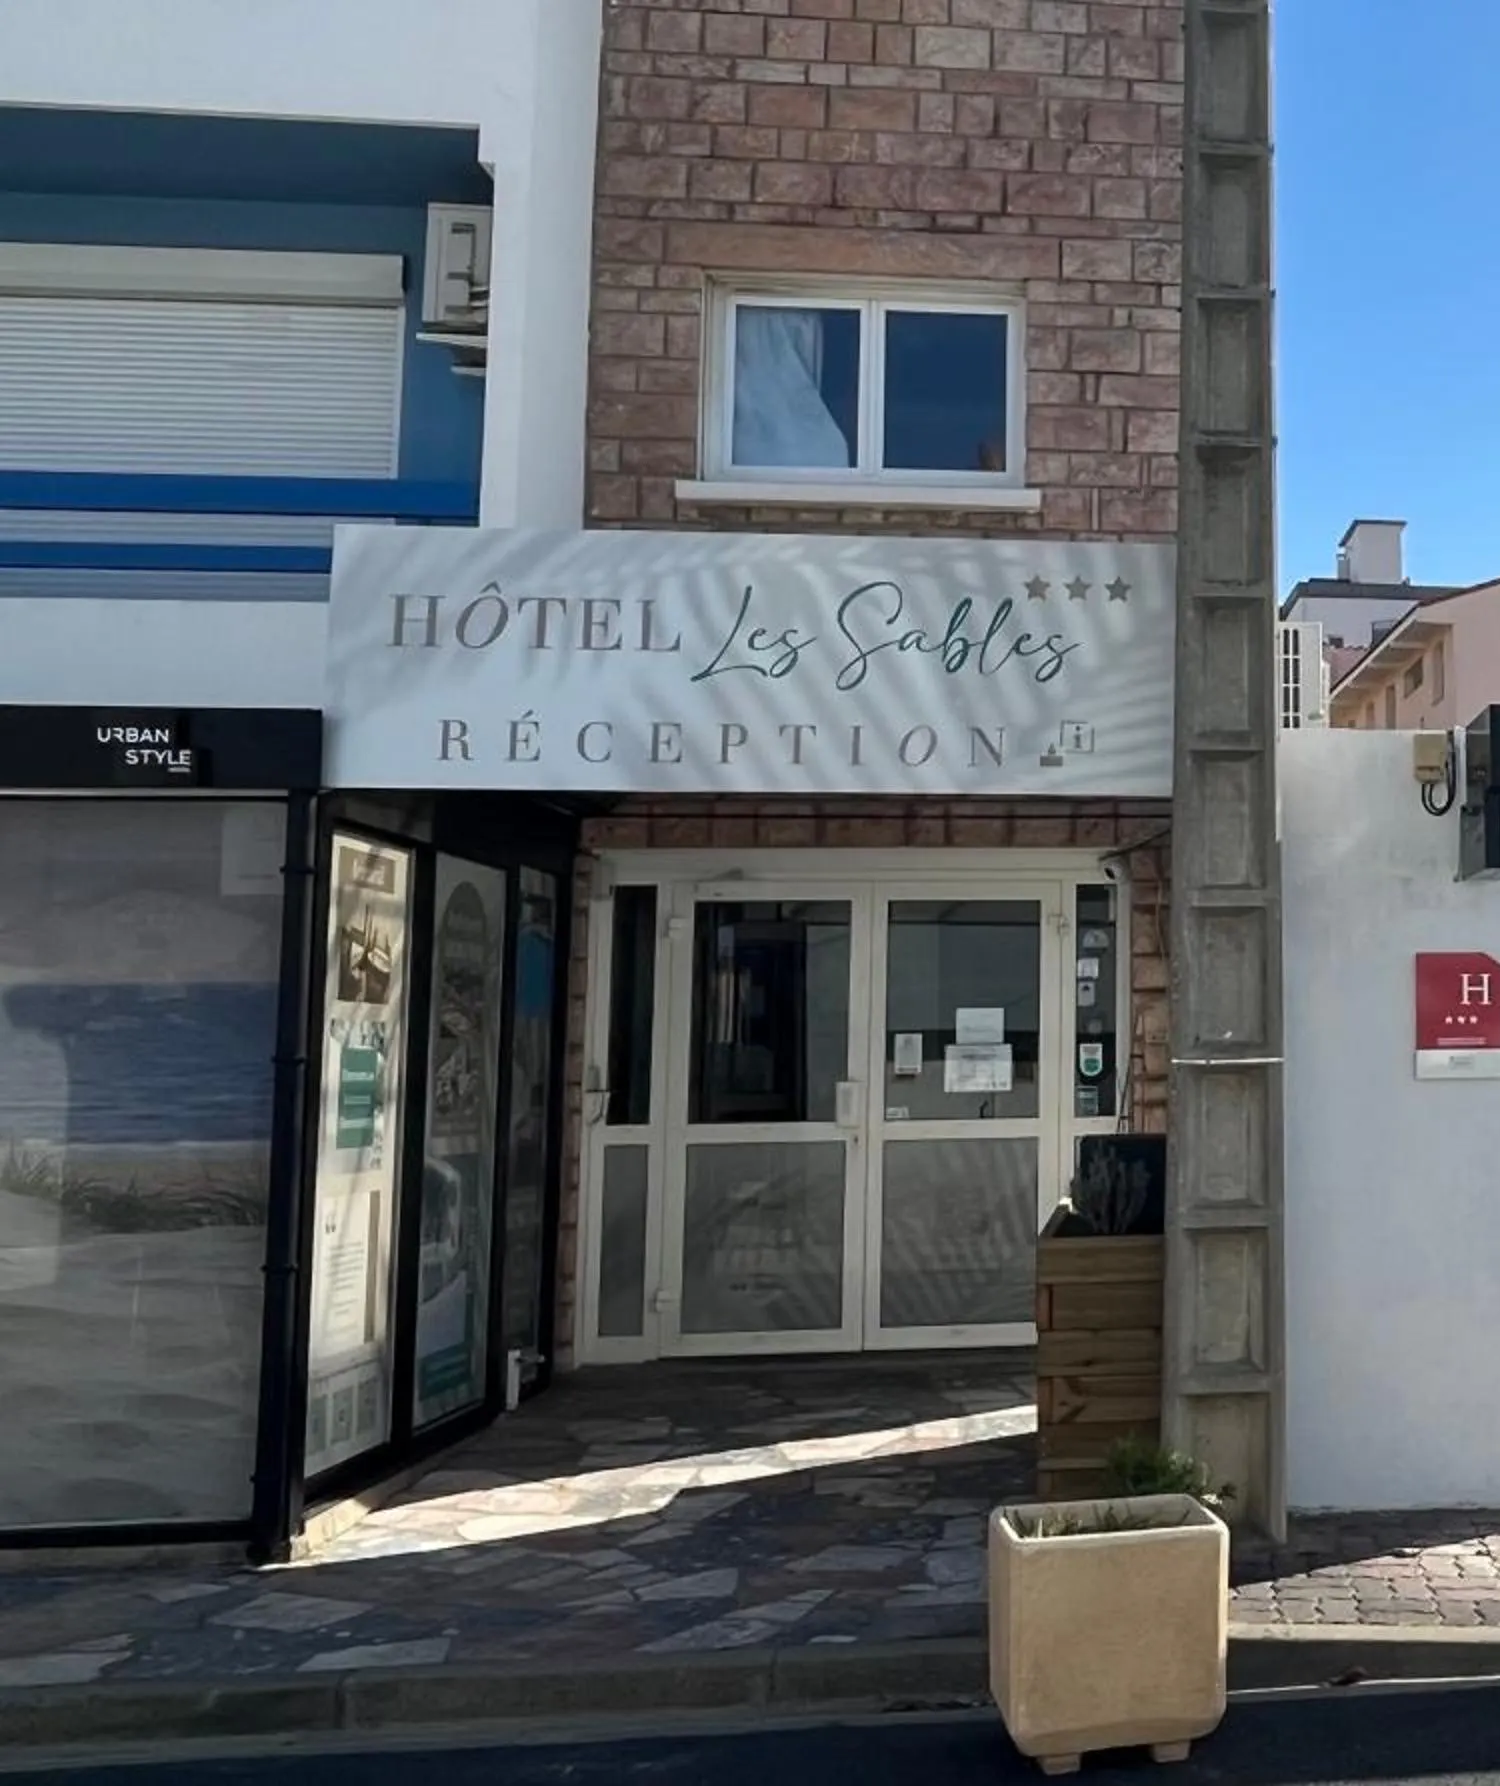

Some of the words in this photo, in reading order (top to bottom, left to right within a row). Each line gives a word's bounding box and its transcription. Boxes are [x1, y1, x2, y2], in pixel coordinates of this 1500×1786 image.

[386, 581, 681, 652] HÔTEL
[690, 585, 816, 680] Les
[835, 581, 1081, 691] Sables
[97, 727, 169, 743] URBAN
[437, 709, 1006, 767] RÉCEPTION
[125, 749, 191, 765] STYLE
[1461, 974, 1491, 1005] H
